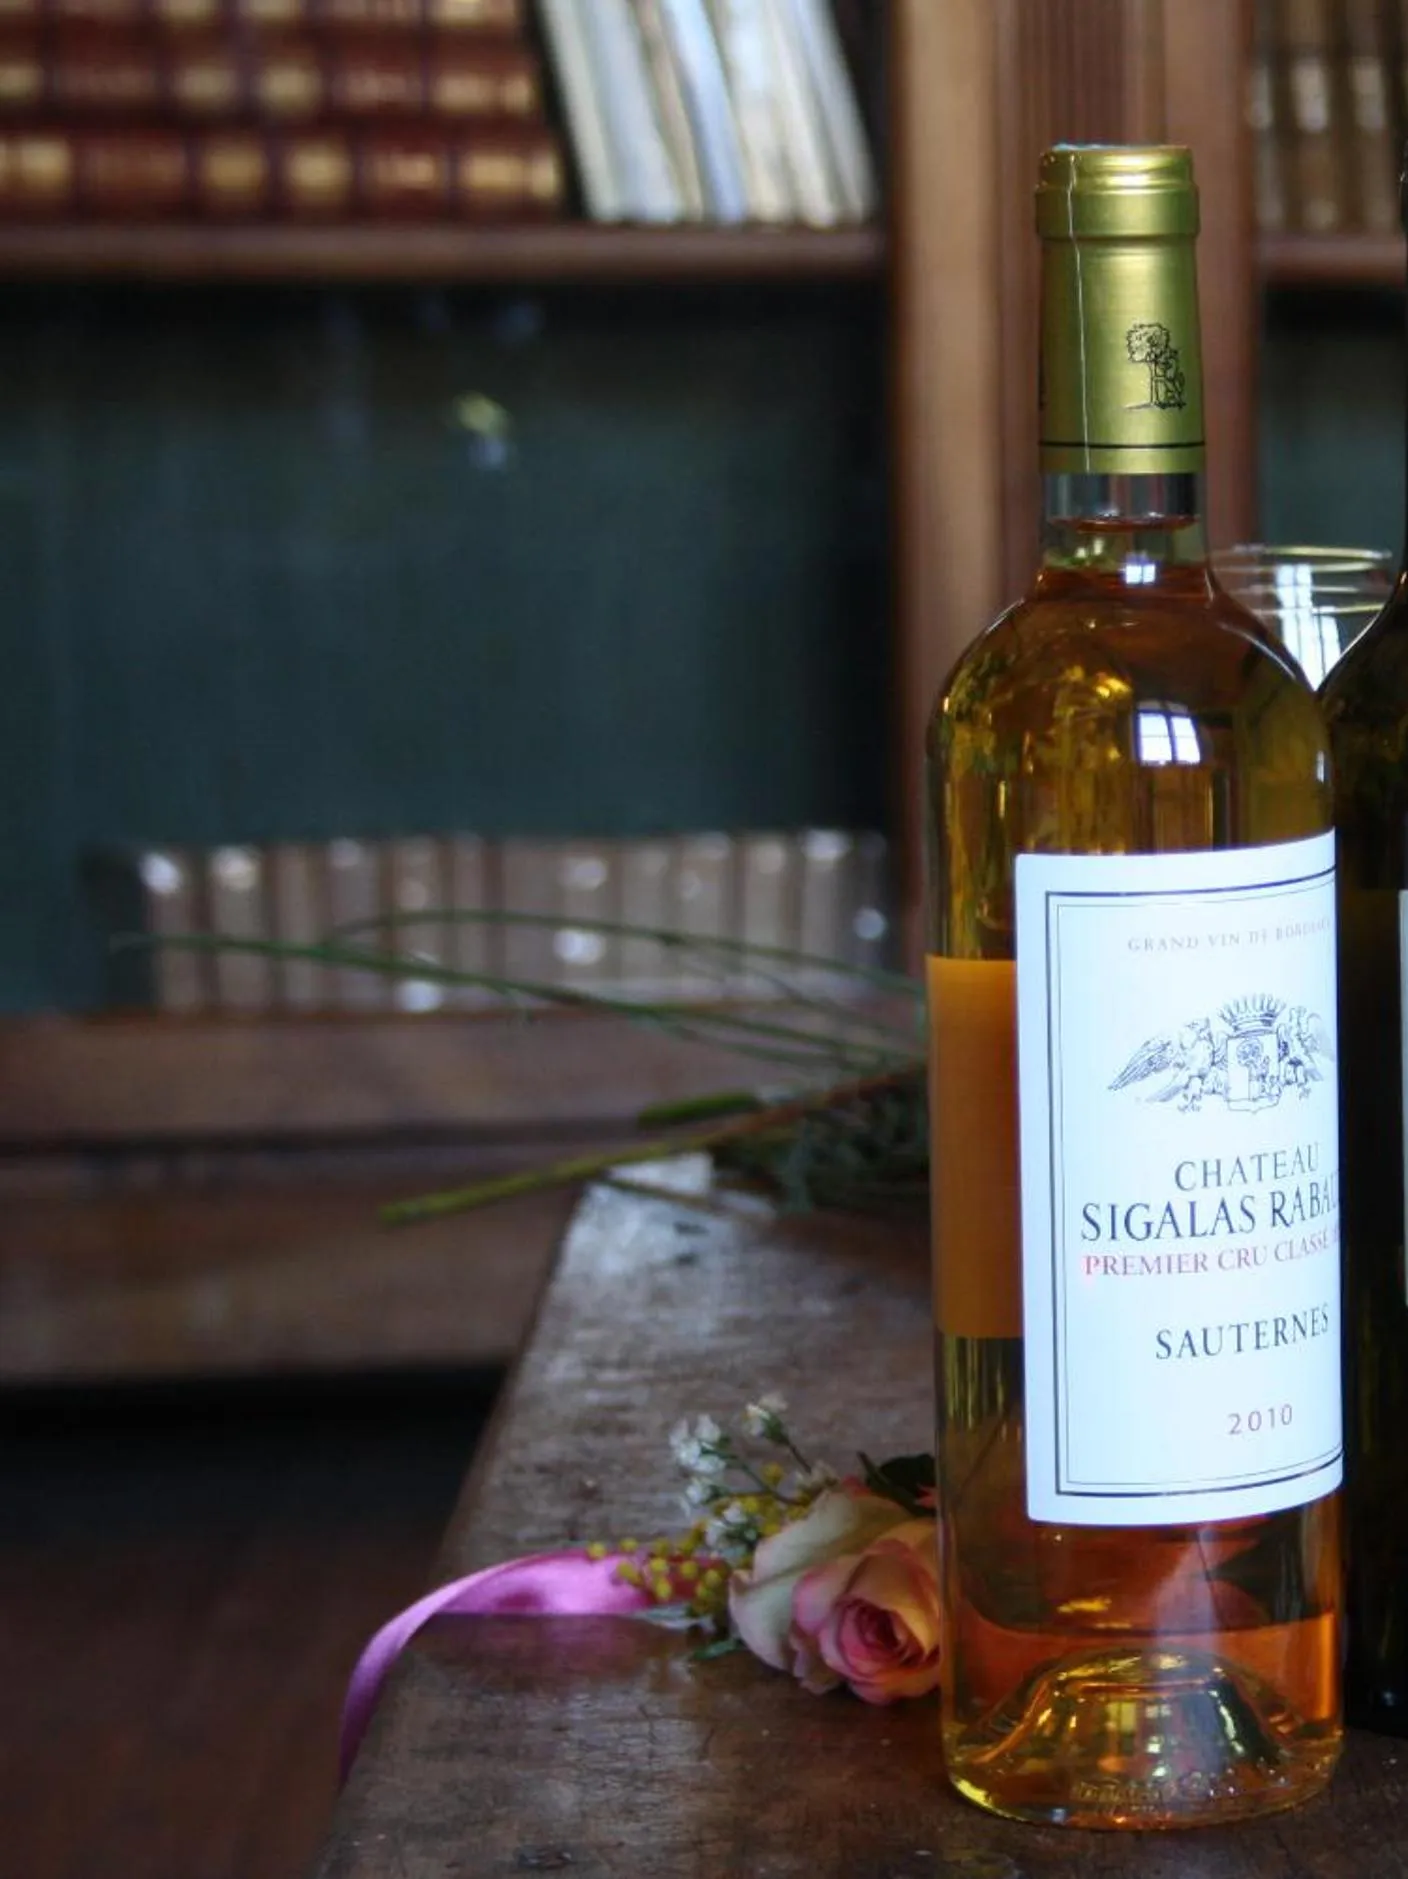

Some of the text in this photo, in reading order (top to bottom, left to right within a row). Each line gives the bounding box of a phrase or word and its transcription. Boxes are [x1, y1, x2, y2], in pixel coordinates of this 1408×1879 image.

[1127, 934, 1199, 952] GRAND
[1208, 930, 1241, 947] VIN
[1174, 1142, 1319, 1191] CHATEAU
[1080, 1195, 1257, 1243] SIGALAS
[1084, 1252, 1209, 1276] PREMIER
[1217, 1246, 1268, 1271] CRU
[1155, 1302, 1330, 1360] SAUTERNES
[1227, 1404, 1294, 1435] 2010
